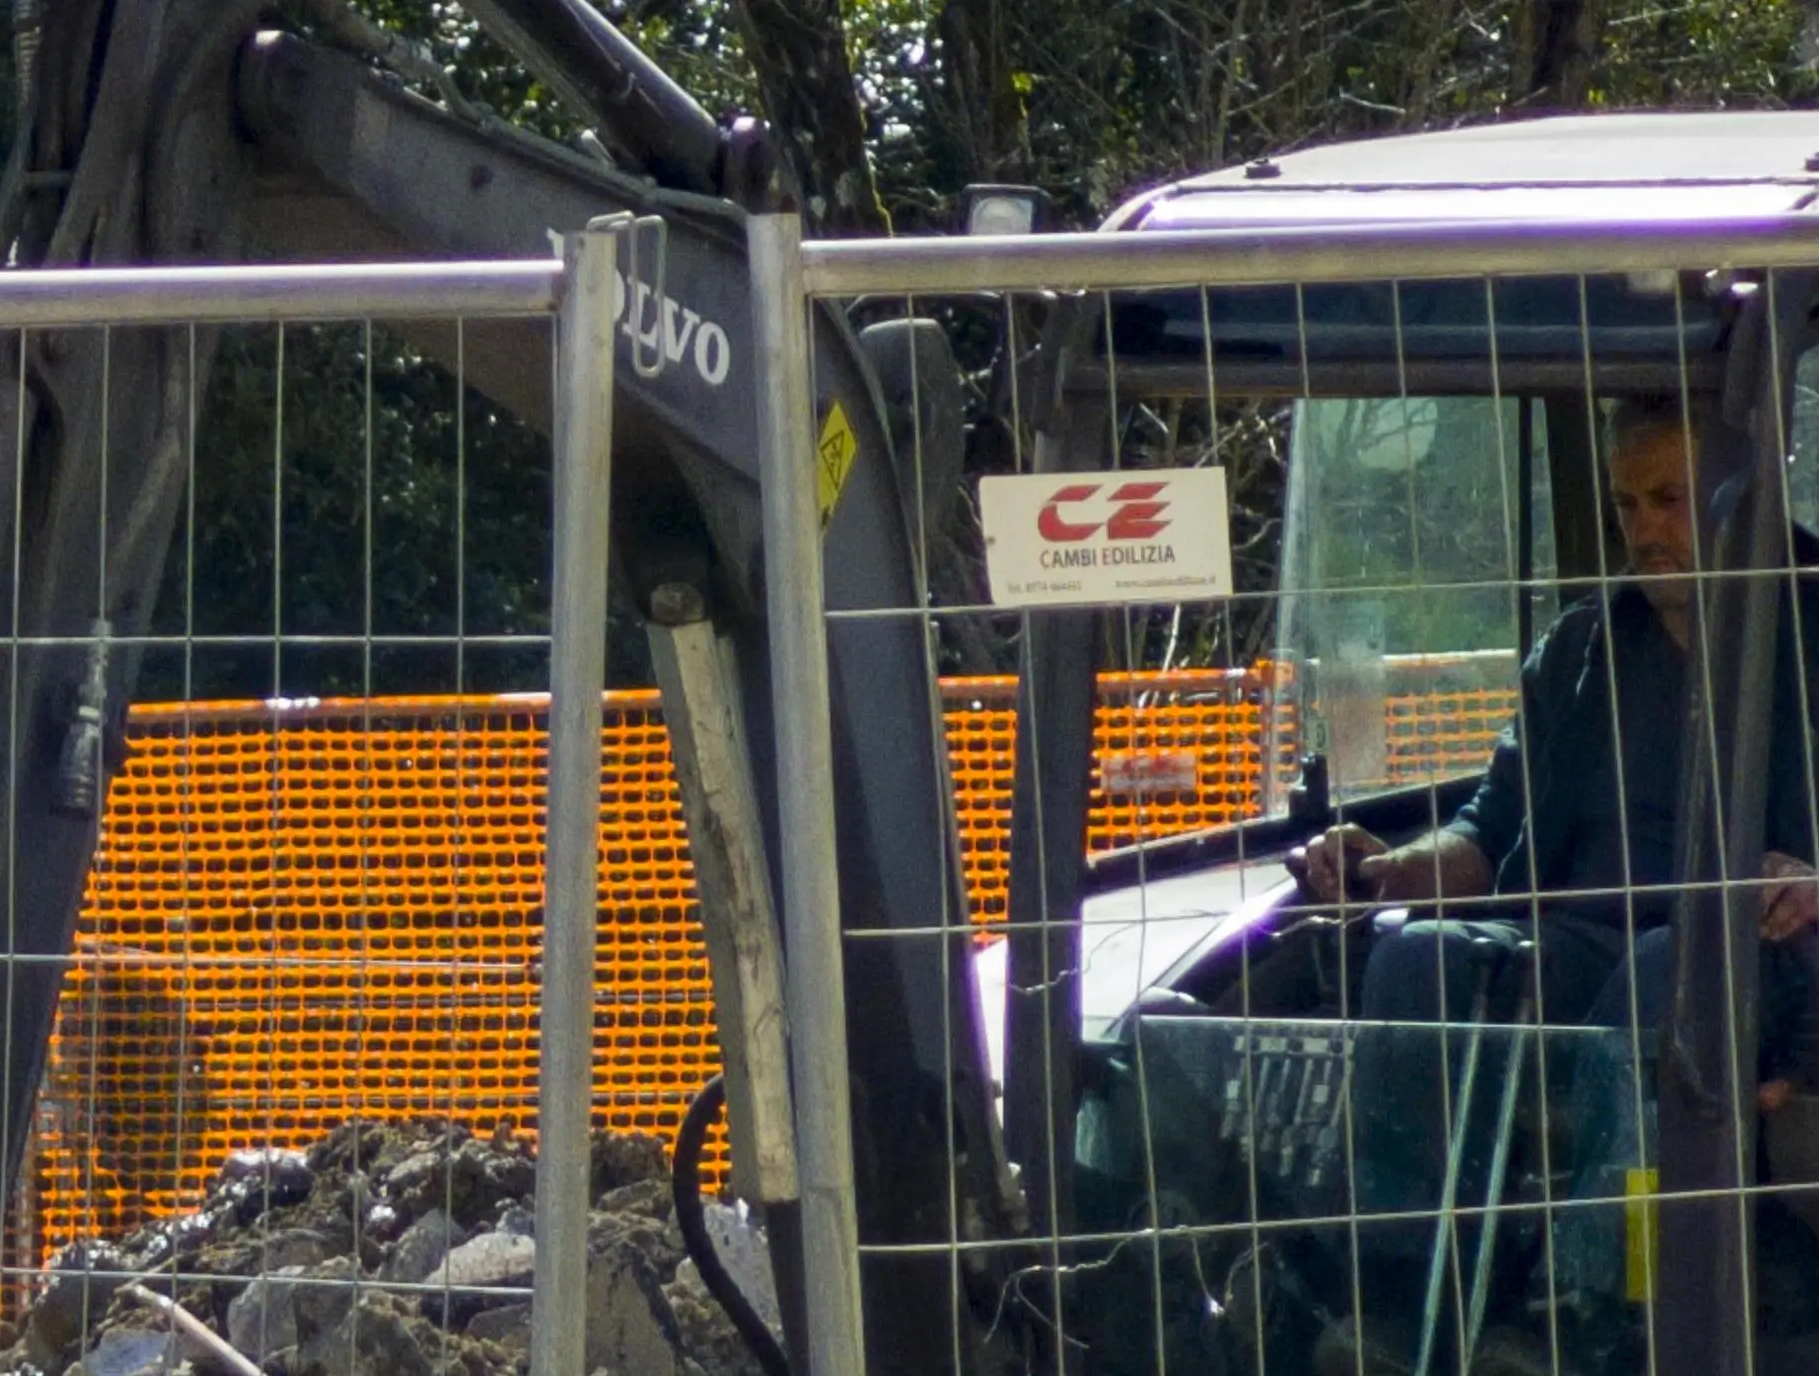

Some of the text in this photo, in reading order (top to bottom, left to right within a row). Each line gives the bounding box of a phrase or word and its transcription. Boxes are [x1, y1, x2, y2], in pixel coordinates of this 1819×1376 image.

[1037, 480, 1175, 543] CE
[1040, 544, 1176, 570] CAMBI EDILIZIA
